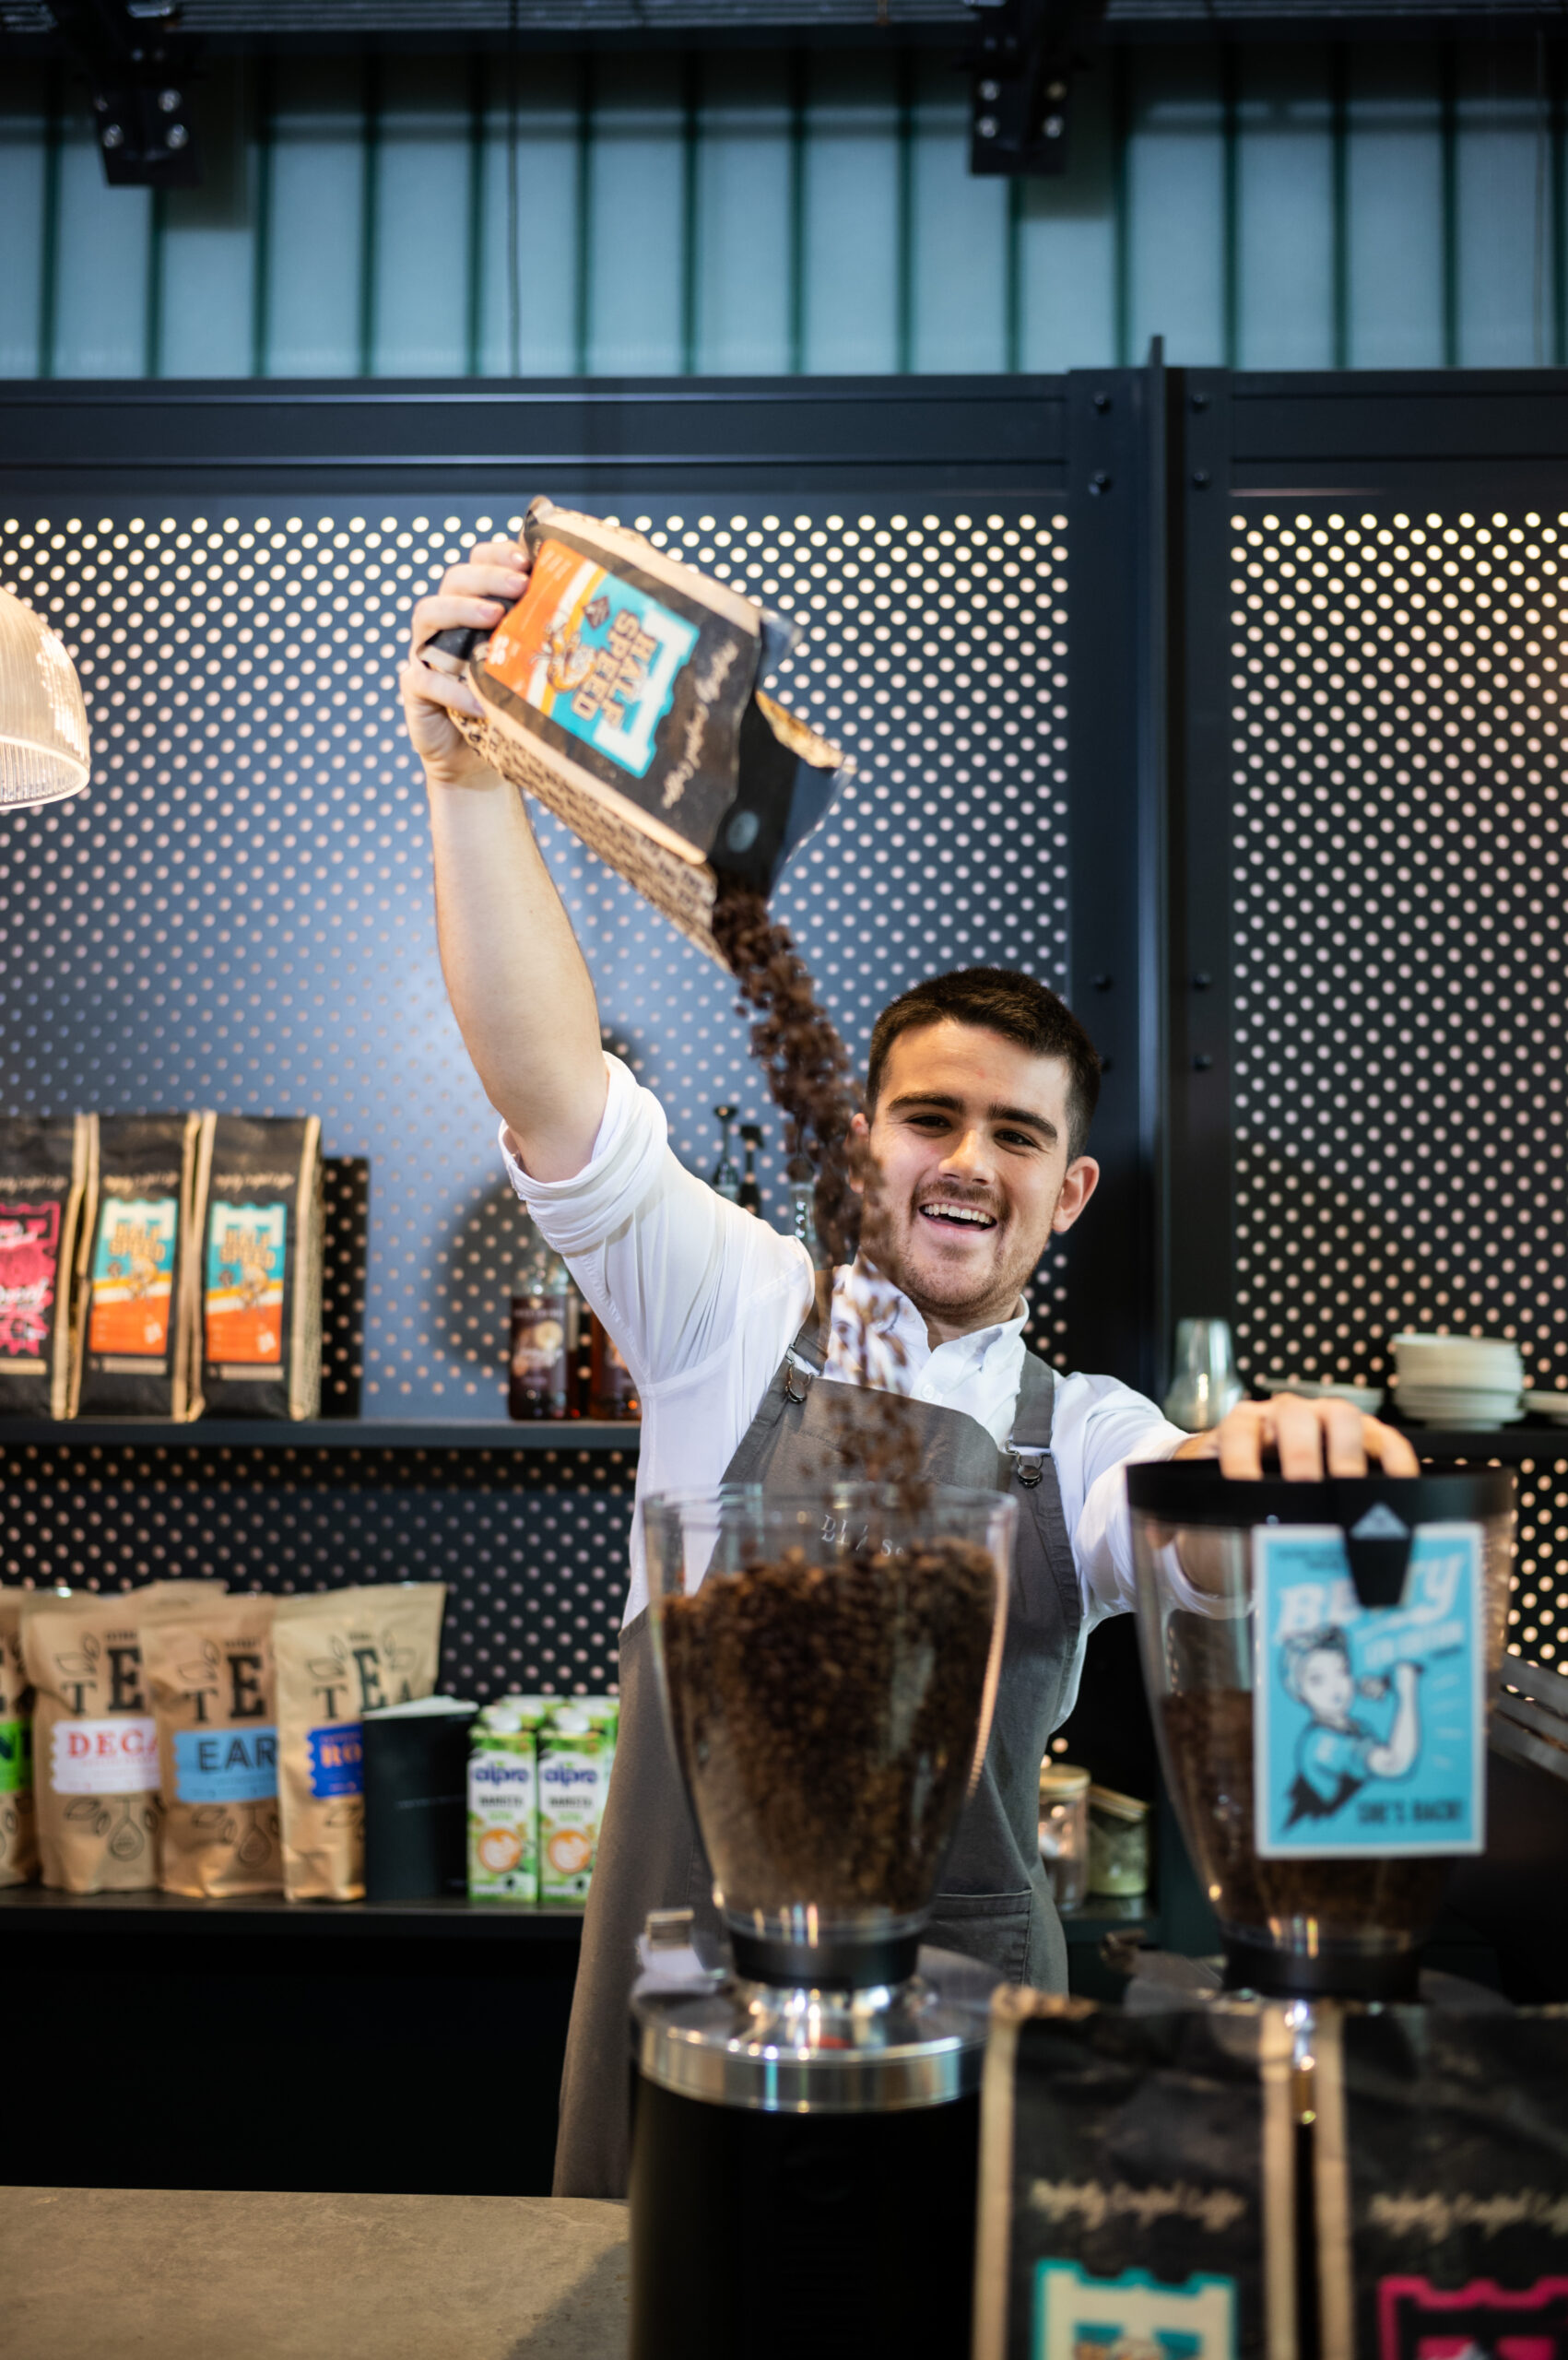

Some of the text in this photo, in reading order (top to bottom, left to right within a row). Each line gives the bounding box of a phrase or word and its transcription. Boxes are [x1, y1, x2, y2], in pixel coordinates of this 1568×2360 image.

[571, 608, 641, 722] SPEED
[609, 631, 657, 729] HALF
[475, 1762, 529, 1788] alpro
[544, 1763, 598, 1788] alpro
